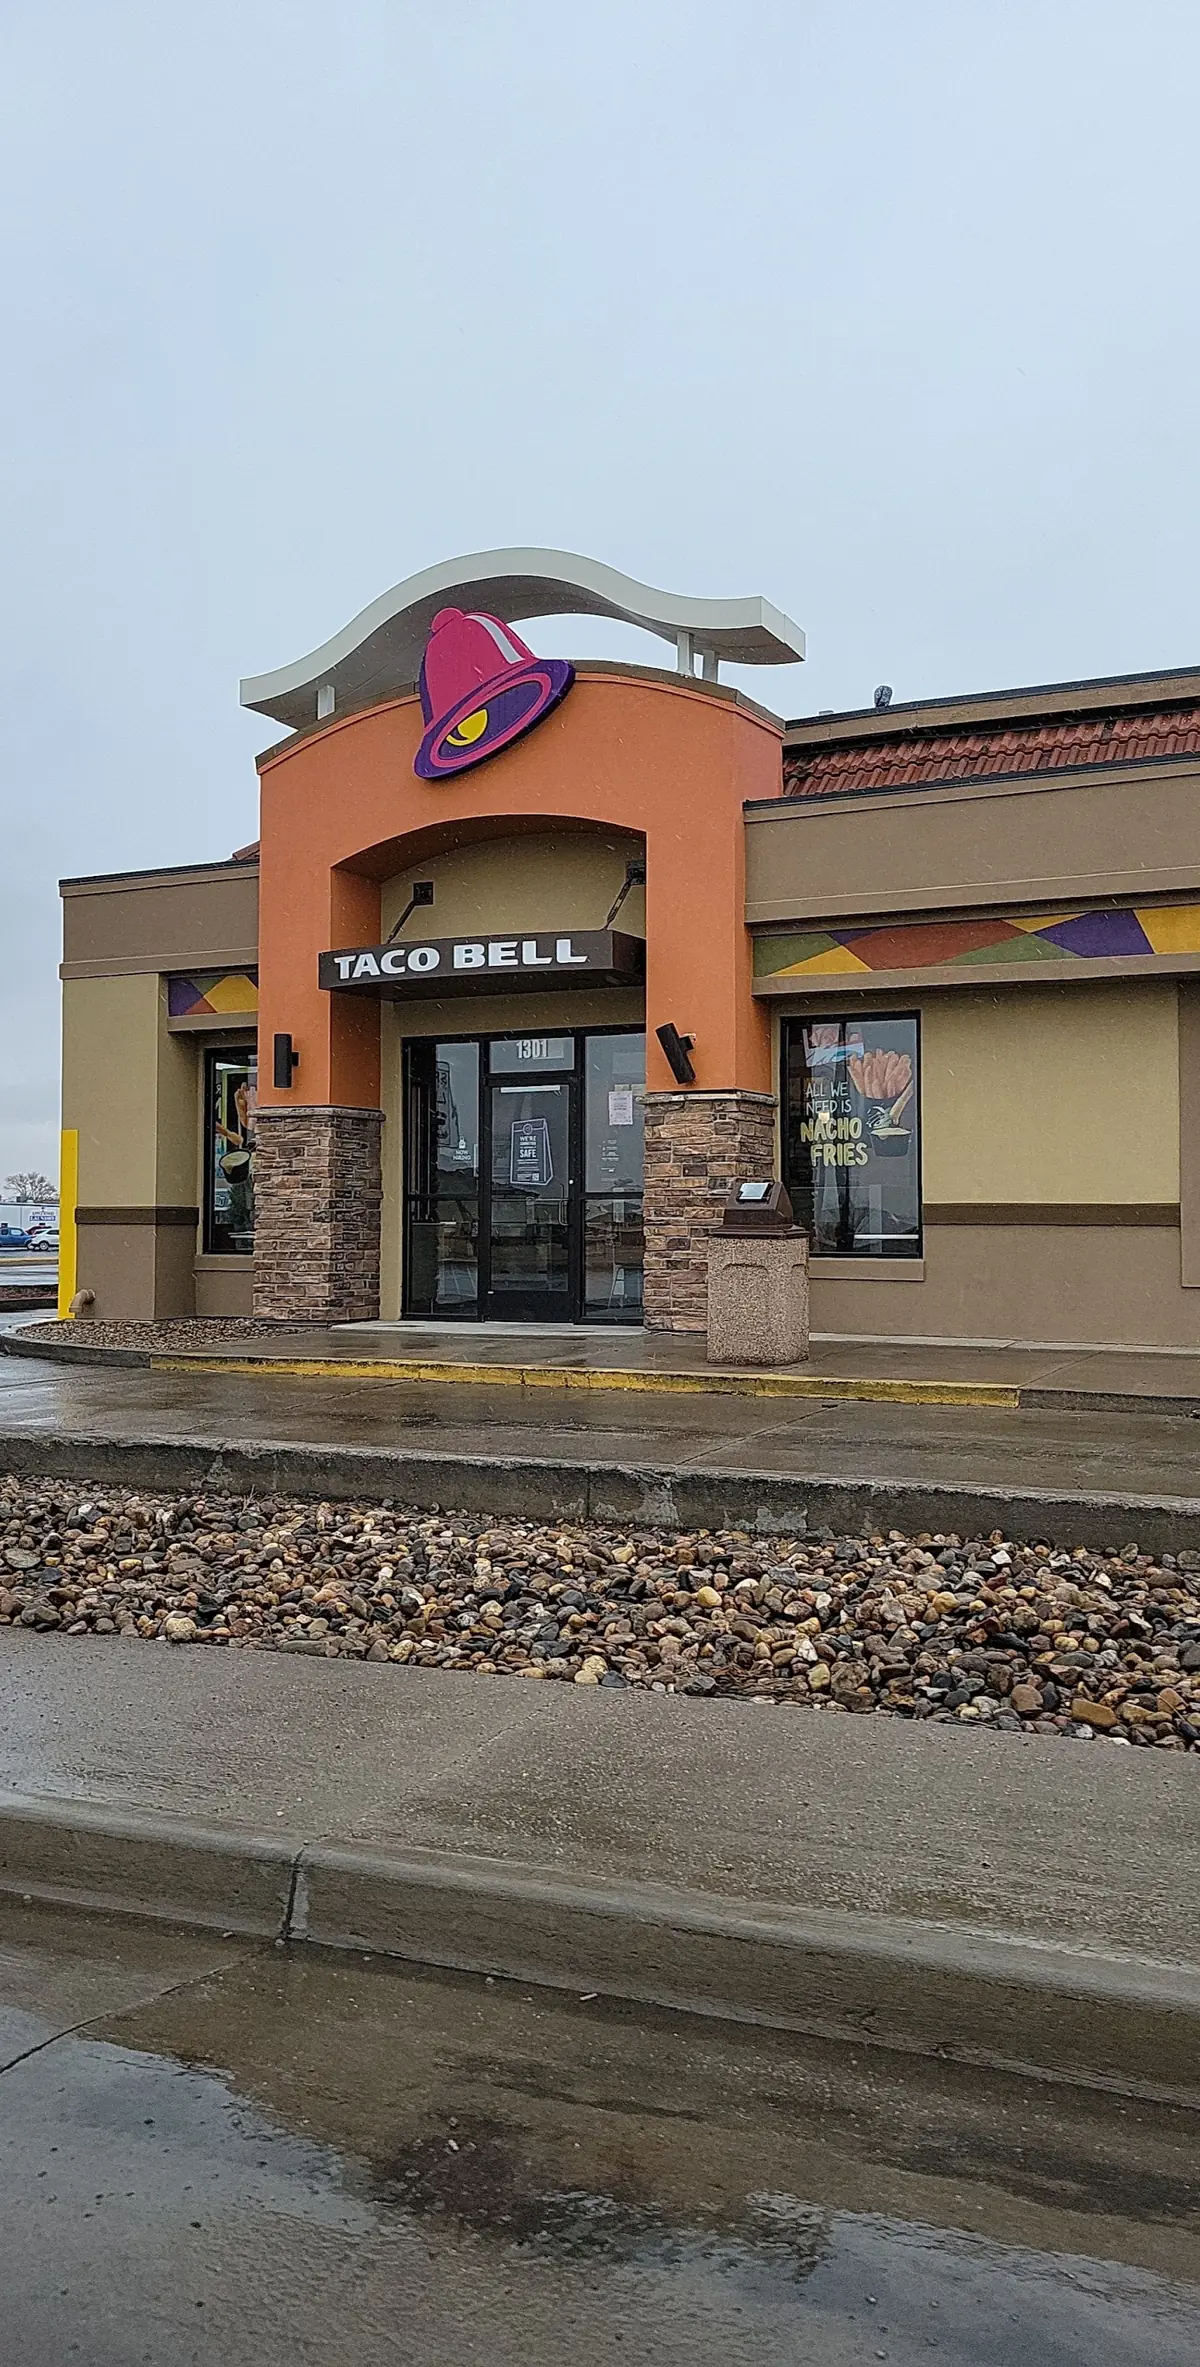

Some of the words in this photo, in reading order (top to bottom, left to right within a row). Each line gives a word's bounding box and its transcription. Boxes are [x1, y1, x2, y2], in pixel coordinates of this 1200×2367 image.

[333, 946, 441, 980] TACO
[453, 938, 590, 970] BELL
[516, 1038, 547, 1059] 1301
[804, 1082, 826, 1098] ALL
[830, 1081, 849, 1098] WE
[805, 1098, 838, 1115] NEED
[841, 1098, 852, 1113] IS
[800, 1117, 862, 1142] NACHO
[519, 1149, 537, 1158] SAFE
[810, 1141, 868, 1167] FRIES
